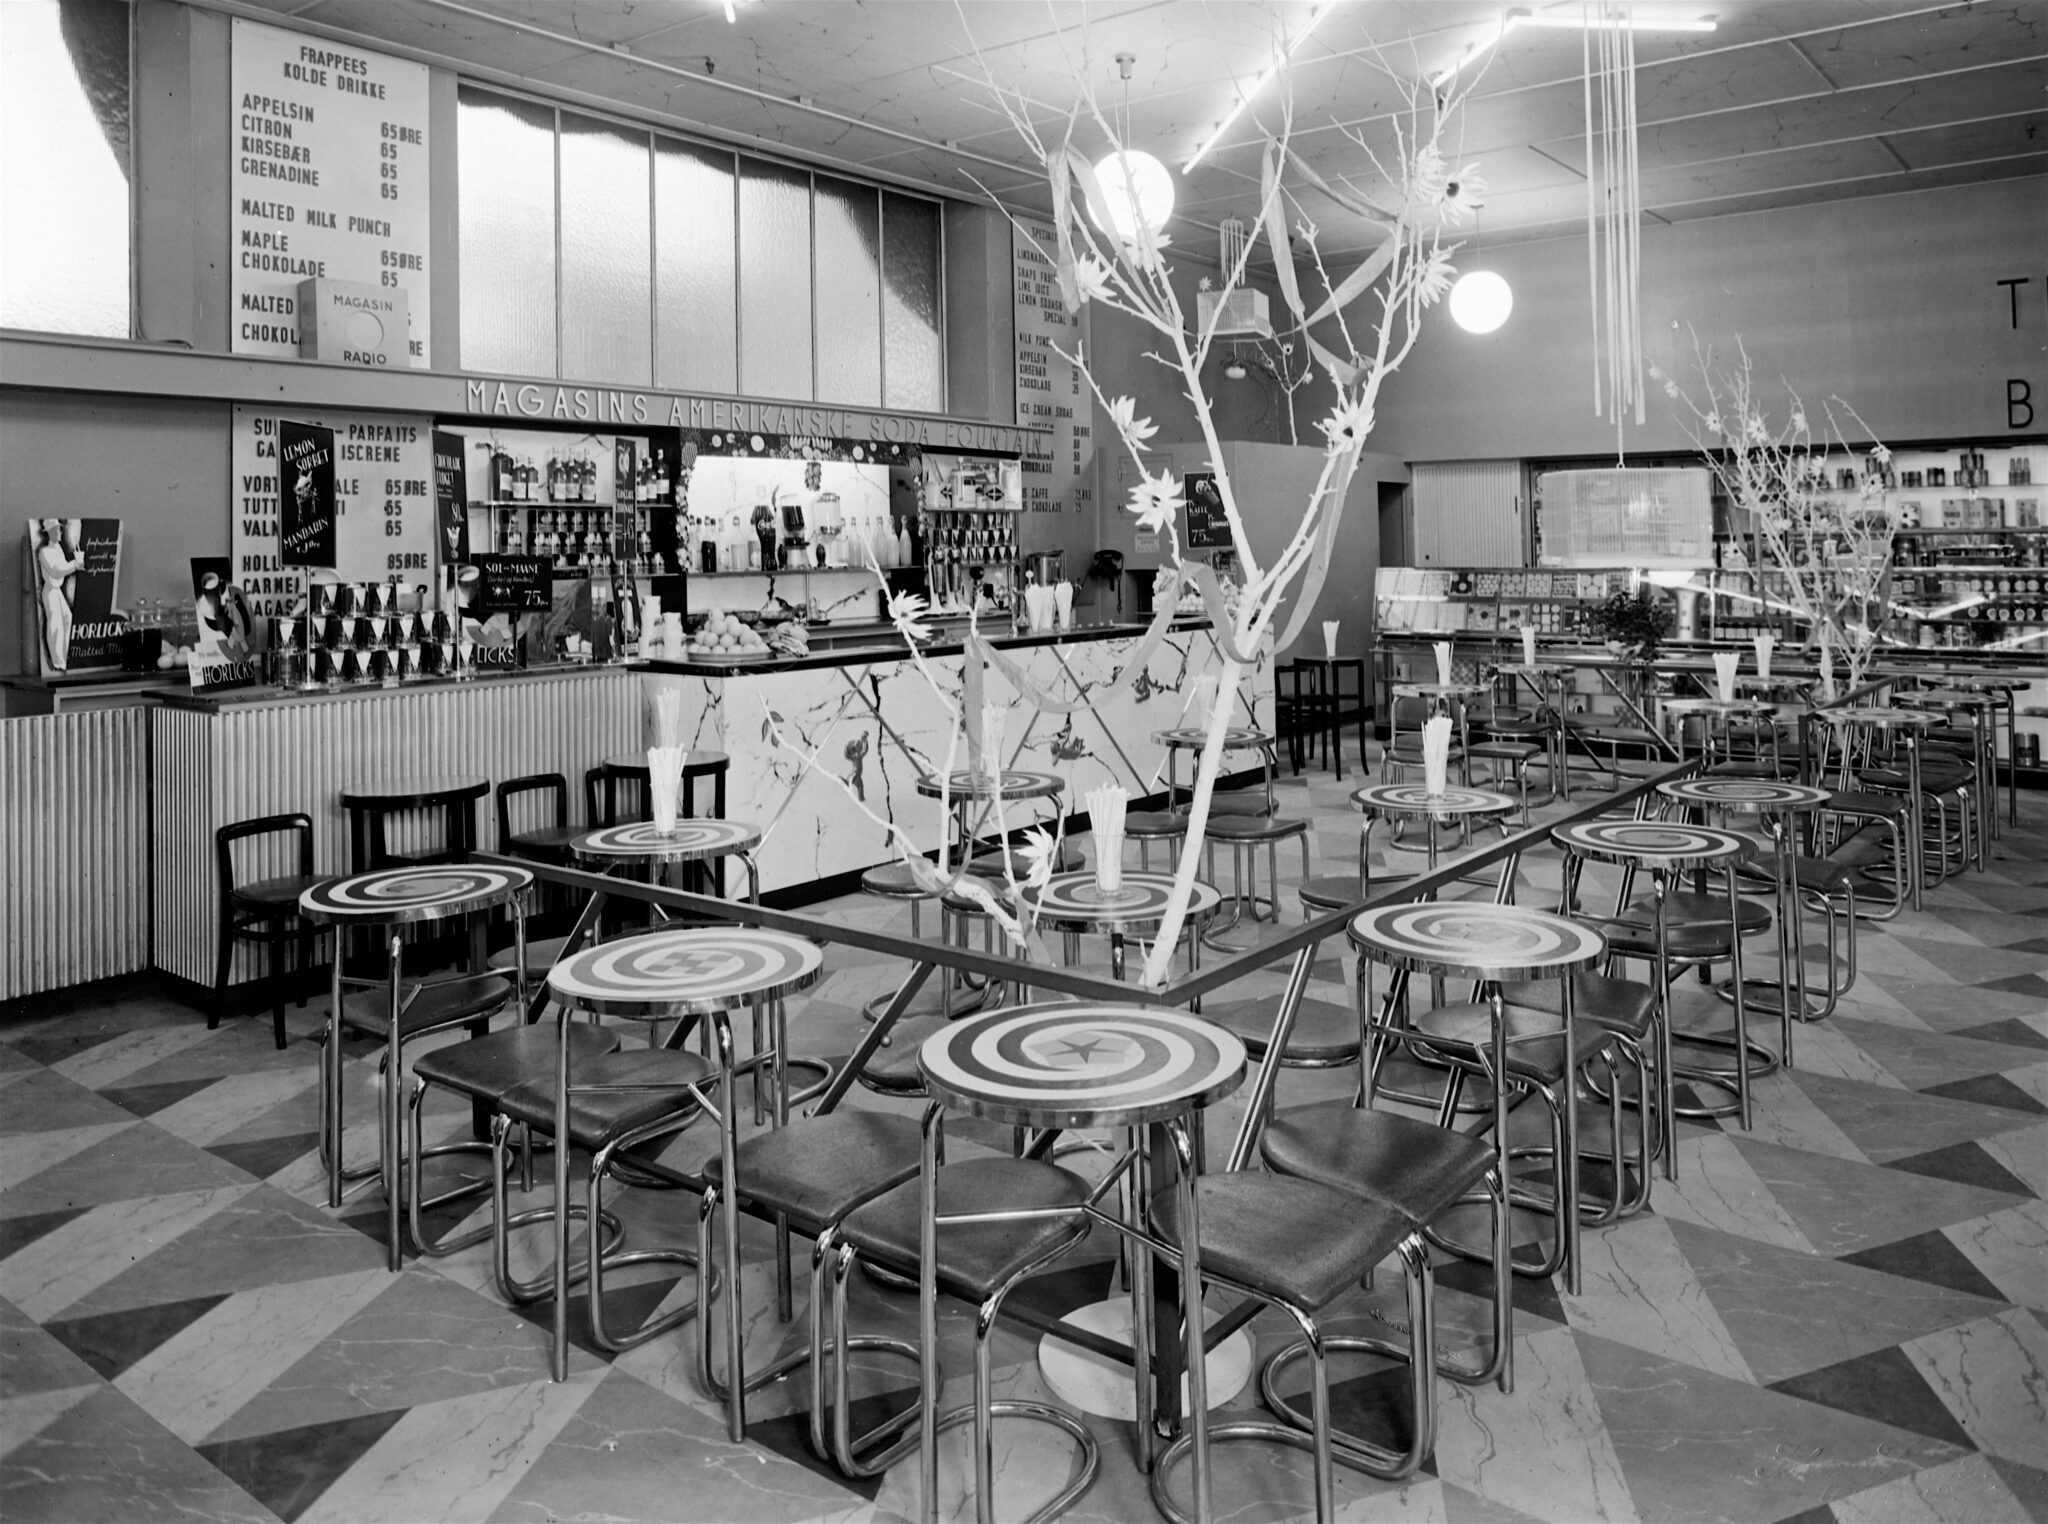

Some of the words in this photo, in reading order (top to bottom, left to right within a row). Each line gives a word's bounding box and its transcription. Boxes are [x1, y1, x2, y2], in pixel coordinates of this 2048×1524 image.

[301, 46, 367, 76] FRAPPEES
[284, 62, 327, 87] KOLDE
[337, 75, 386, 100] DRIKKE
[242, 93, 314, 123] APPELSIN
[242, 115, 292, 139] CITRON
[242, 136, 311, 164] KIRSEBÆR
[381, 142, 398, 160] 65
[242, 158, 320, 187] GRENADINE
[381, 162, 398, 180] 65
[381, 183, 398, 200] 65
[242, 199, 295, 222] MALTED
[307, 209, 336, 230] MILK
[348, 216, 391, 238] PUNCH
[242, 230, 288, 252] MAPLE
[242, 252, 326, 278] CHOKOLADE
[381, 271, 398, 288] 65
[242, 294, 294, 316] MALTED
[334, 294, 393, 312] MAGASIN
[1018, 293, 1036, 306] LEMON
[1040, 298, 1062, 312] SQUASH
[1044, 311, 1066, 326] SPECIAL
[242, 323, 302, 346] CHOKOL
[1019, 332, 1032, 344] MILK
[1036, 335, 1052, 348] PUNC
[344, 350, 386, 366] RADIO
[1020, 350, 1046, 365] APPELSIN
[1020, 377, 1051, 392] CHOKOLADE
[466, 379, 648, 423] MAGASINS
[669, 396, 853, 440] AMERIKANSKE
[869, 415, 930, 443] SODA
[945, 421, 1042, 455] FOUNTAIN
[1020, 403, 1029, 414] ICE
[1034, 404, 1052, 416] CREAM
[1056, 406, 1073, 418] SODAS
[349, 424, 416, 443] PARFAITS
[284, 436, 316, 462] LEMON
[342, 444, 400, 462] ISCREME
[296, 448, 328, 473] SORBET
[1022, 461, 1052, 474] CHOKOLADE
[1032, 488, 1048, 500] CAFFE
[243, 498, 277, 515] TUTT
[385, 500, 402, 516] 65
[1032, 500, 1062, 513] CHOKOLADE
[283, 516, 328, 551] MANDARIN
[385, 520, 402, 536] 65
[1191, 529, 1206, 543] 75
[485, 562, 502, 574] SOL
[524, 590, 541, 606] 75
[70, 646, 104, 658] Malted
[476, 646, 514, 664] LICKS
[204, 660, 254, 685] HORLICKS
